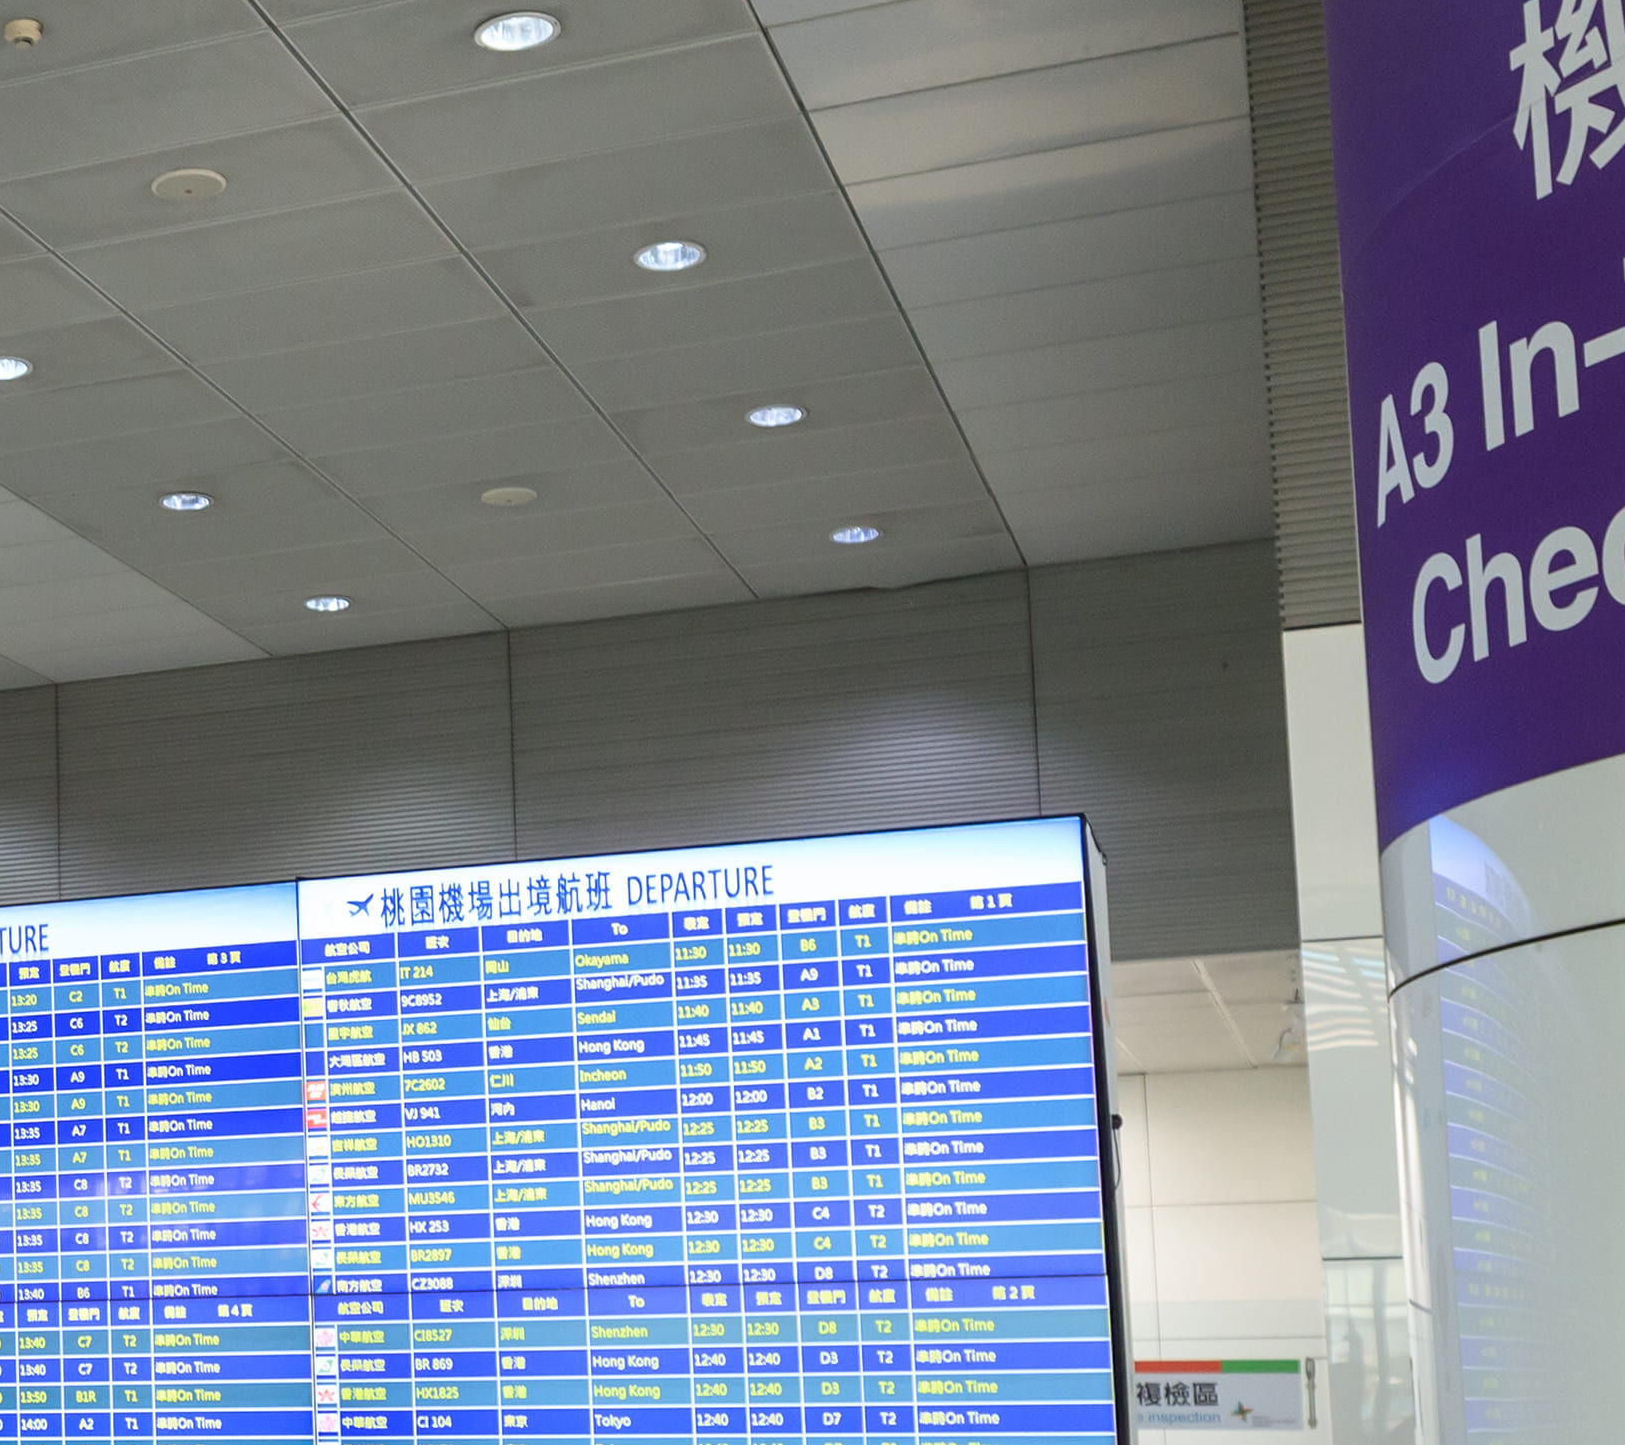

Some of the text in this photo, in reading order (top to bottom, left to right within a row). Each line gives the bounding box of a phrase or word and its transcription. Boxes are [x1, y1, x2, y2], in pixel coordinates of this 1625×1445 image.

[1373, 361, 1454, 527] A3
[381, 864, 775, 927] 桃園機場出境航班 DEPARTURE
[612, 922, 628, 936] To
[413, 965, 434, 978] 214
[575, 952, 629, 968] Okayama
[675, 946, 707, 961] 11:30
[800, 938, 817, 952] B6
[855, 934, 871, 948] T1
[941, 928, 973, 942] Time
[401, 993, 442, 1008] 9C8952
[575, 973, 664, 991] Shanghai/Pudo
[676, 975, 708, 989] 11:35
[800, 968, 818, 981] A9
[416, 1021, 437, 1035] 862
[577, 1010, 616, 1025] Sendai
[678, 1004, 710, 1019] 11:40
[403, 1033, 710, 1064] HB 503 Hong Kong 11:45
[404, 1078, 446, 1092] 7C2602
[579, 1069, 627, 1083] Incheon
[1149, 1412, 1221, 1424] inspection
